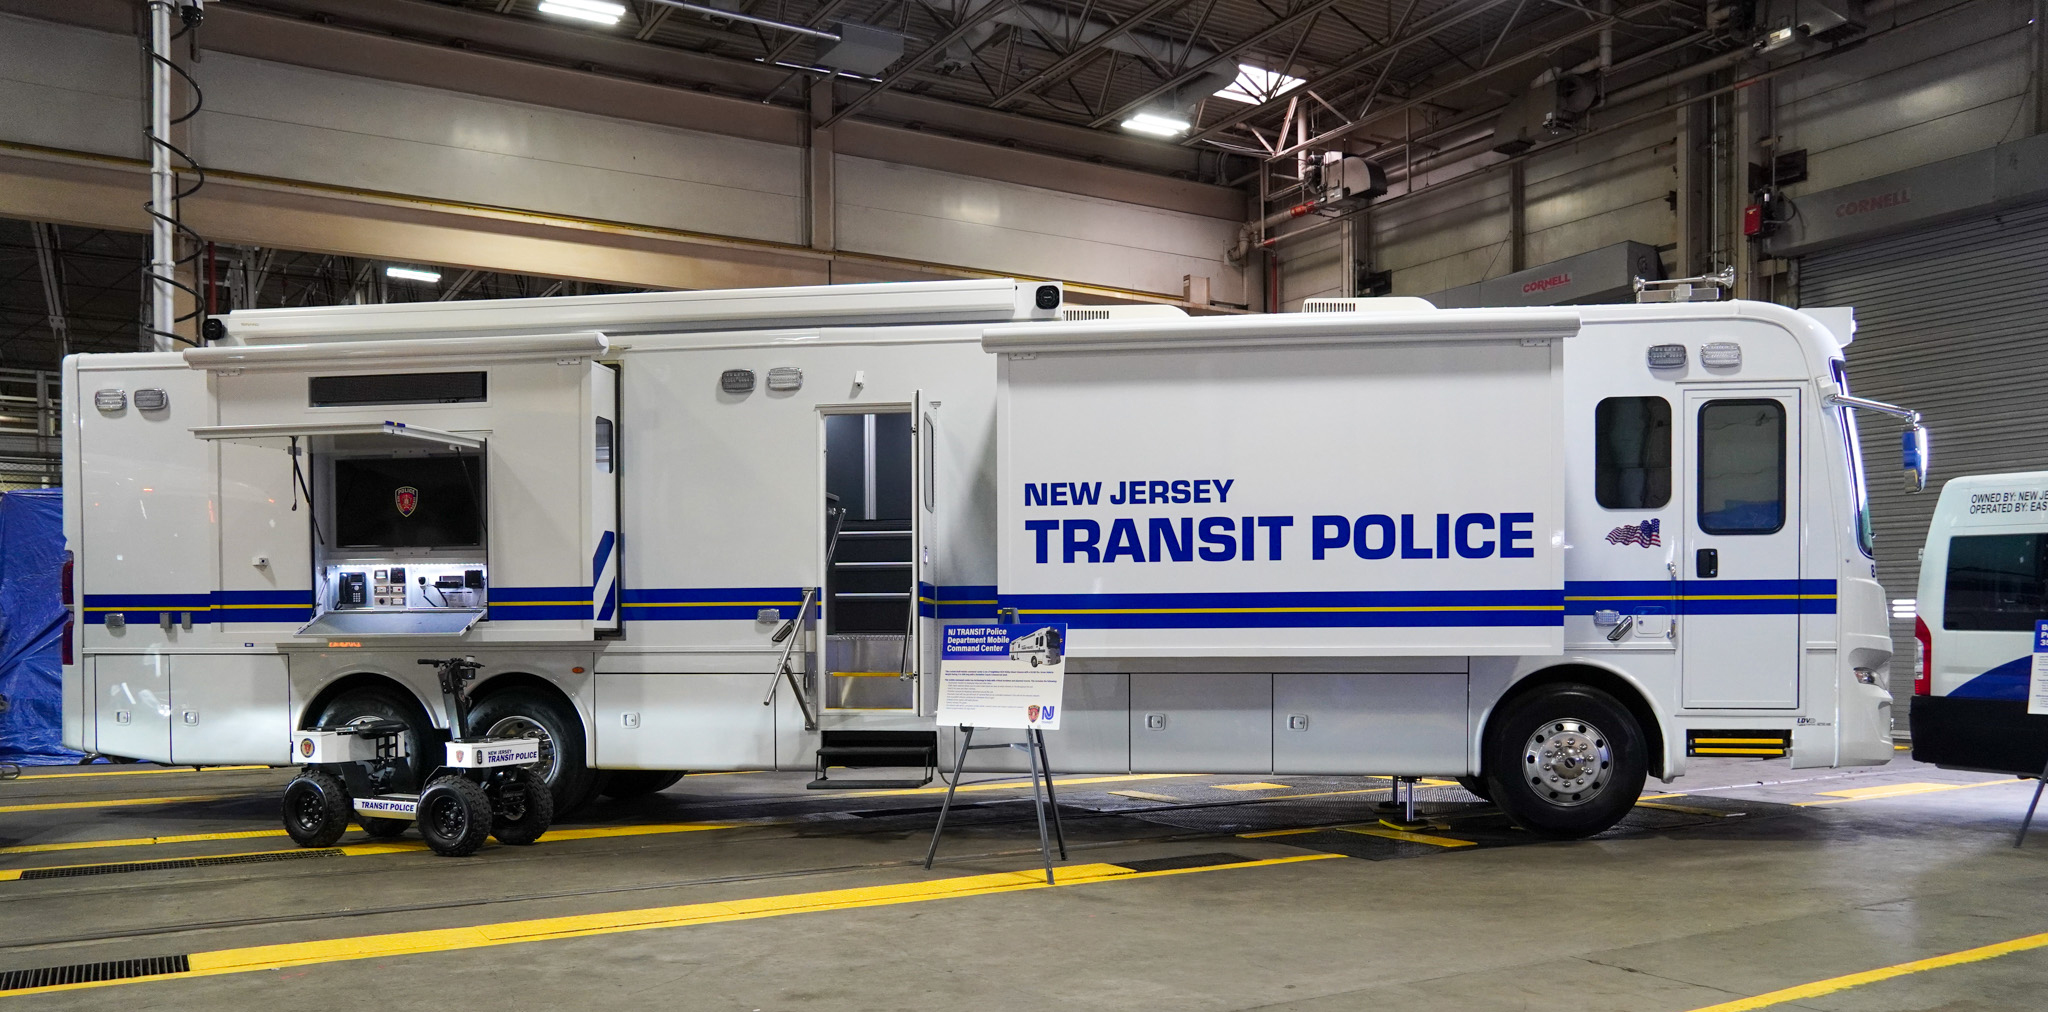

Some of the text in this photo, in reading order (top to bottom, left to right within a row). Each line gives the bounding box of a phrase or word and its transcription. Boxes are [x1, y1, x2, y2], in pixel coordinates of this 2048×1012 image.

[1835, 190, 1910, 217] CORNELL
[1522, 273, 1572, 293] CORNELL
[1024, 479, 1235, 506] NEW JERSEY
[1971, 493, 2001, 504] OWNED
[2003, 492, 2016, 502] BY:
[2018, 490, 2038, 501] NEW
[1969, 503, 2013, 514] OPERATED
[2014, 502, 2028, 512] BY:
[1025, 512, 1535, 564] TRANSIT POLICE
[947, 636, 986, 645] Department
[488, 751, 538, 763] TRANSIT POLICE
[361, 801, 415, 812] TRANSIT POLICE
